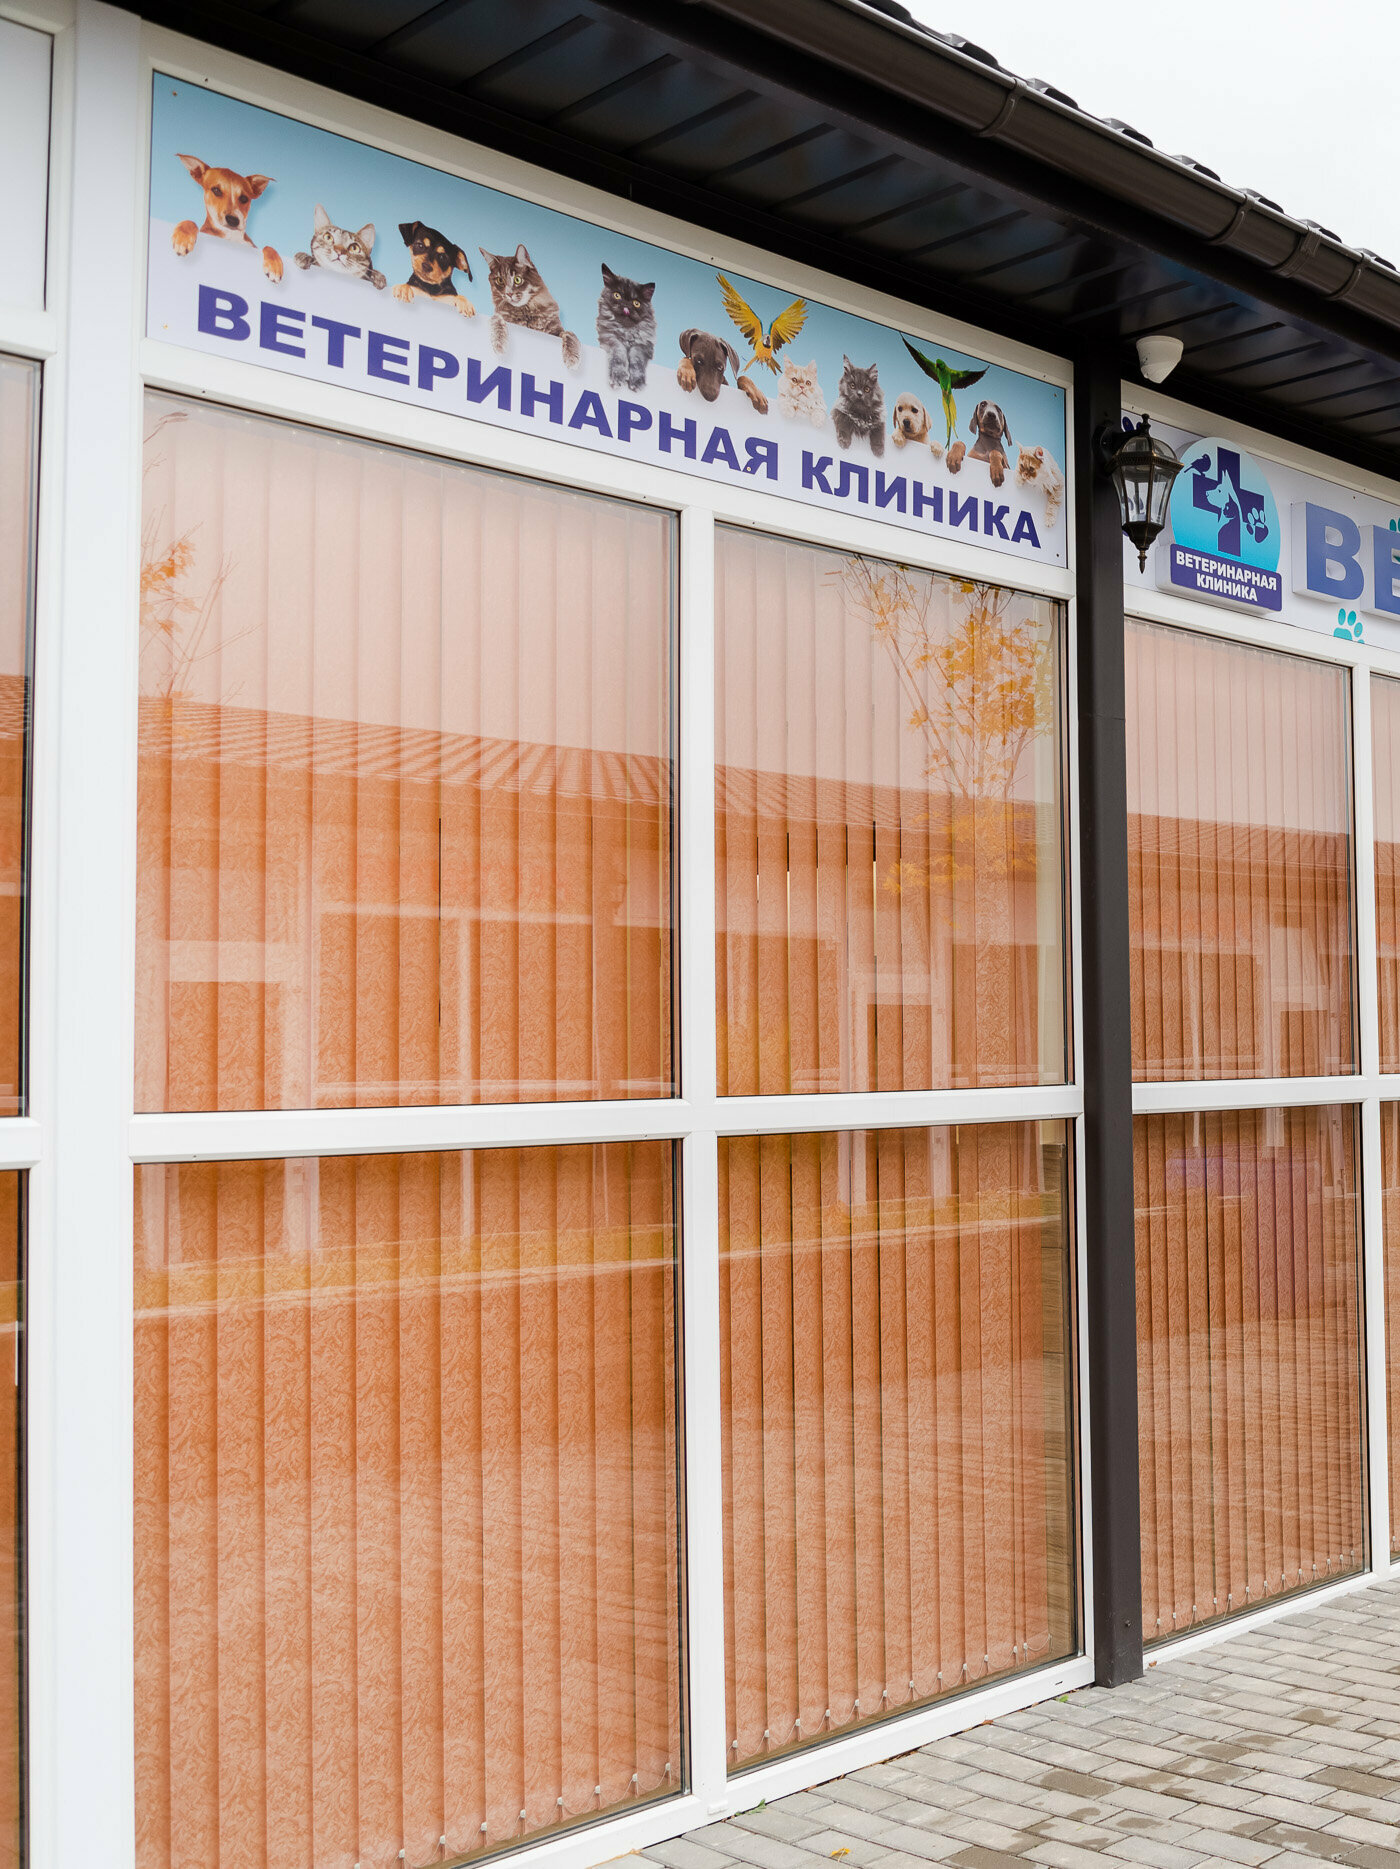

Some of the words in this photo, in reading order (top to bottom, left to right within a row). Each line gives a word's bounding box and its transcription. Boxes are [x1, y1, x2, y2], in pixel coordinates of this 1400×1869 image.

[198, 283, 779, 481] ВЕТЕРИНАРНАЯ
[800, 454, 1043, 549] КЛИНИКА
[1176, 550, 1277, 591] ВЕТЕРИНАРНАЯ
[1196, 573, 1258, 602] КЛИНИКА
